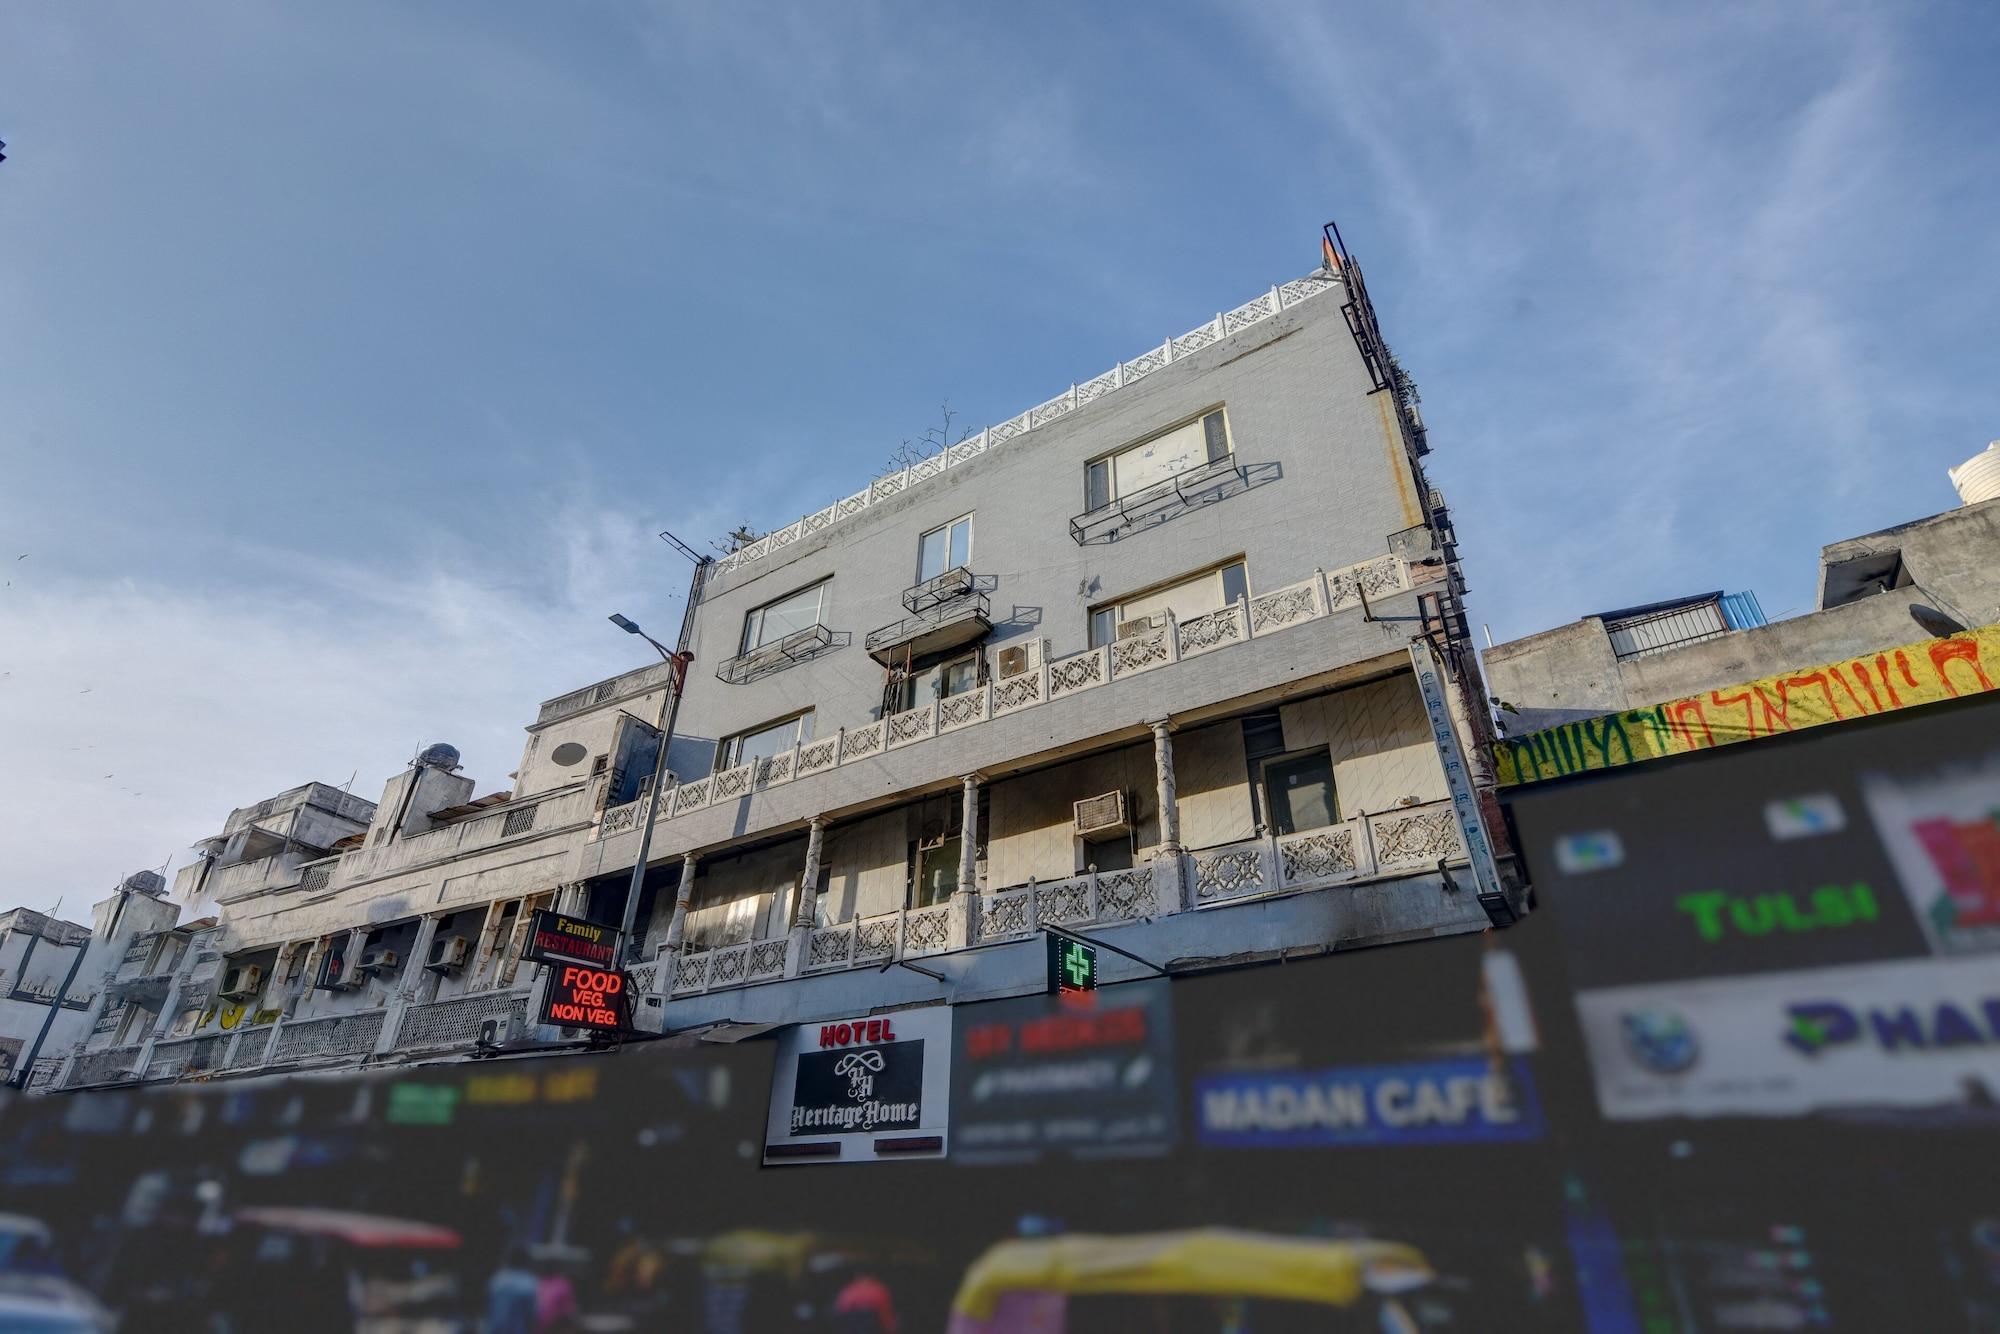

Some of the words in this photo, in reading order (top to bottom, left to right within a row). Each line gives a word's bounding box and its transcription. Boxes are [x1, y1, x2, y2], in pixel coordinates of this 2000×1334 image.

[1677, 881, 1879, 943] TULSI
[557, 917, 603, 943] Family
[535, 931, 615, 962] RESTAURANT
[562, 966, 622, 994] FOOD
[572, 990, 607, 1008] VEG.
[551, 1004, 586, 1022] NON
[587, 1008, 618, 1026] VEG.
[1784, 992, 2000, 1056] PHA
[820, 1018, 897, 1048] HOTEL
[1202, 1084, 1363, 1131] MADAN
[1375, 1073, 1517, 1126] CAFE
